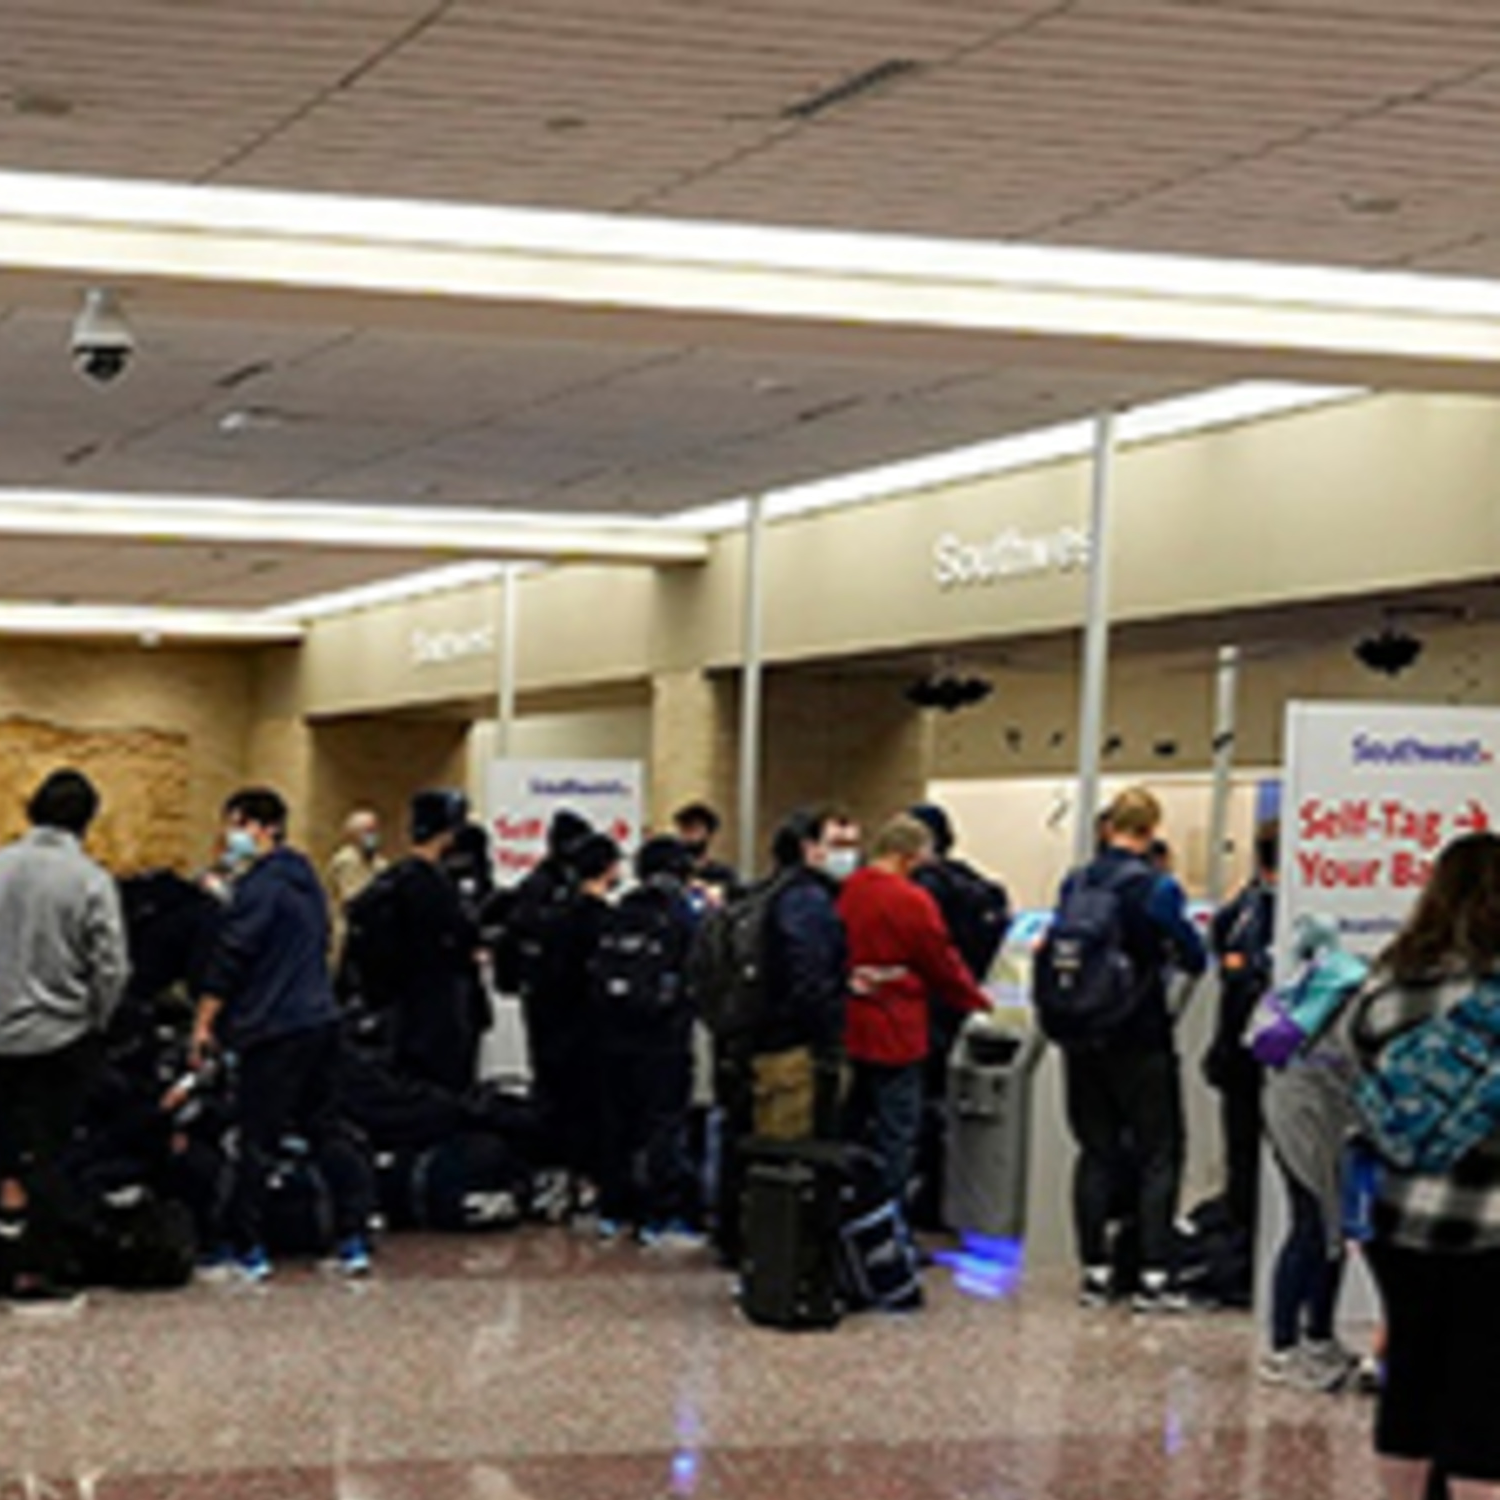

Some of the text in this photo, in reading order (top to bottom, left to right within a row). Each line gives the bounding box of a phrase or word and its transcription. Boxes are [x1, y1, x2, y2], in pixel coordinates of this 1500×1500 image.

[933, 526, 1094, 584] Southwes
[494, 815, 543, 840] Self
[1299, 799, 1441, 849] Self-Tag
[1297, 850, 1436, 888] Your Ba
